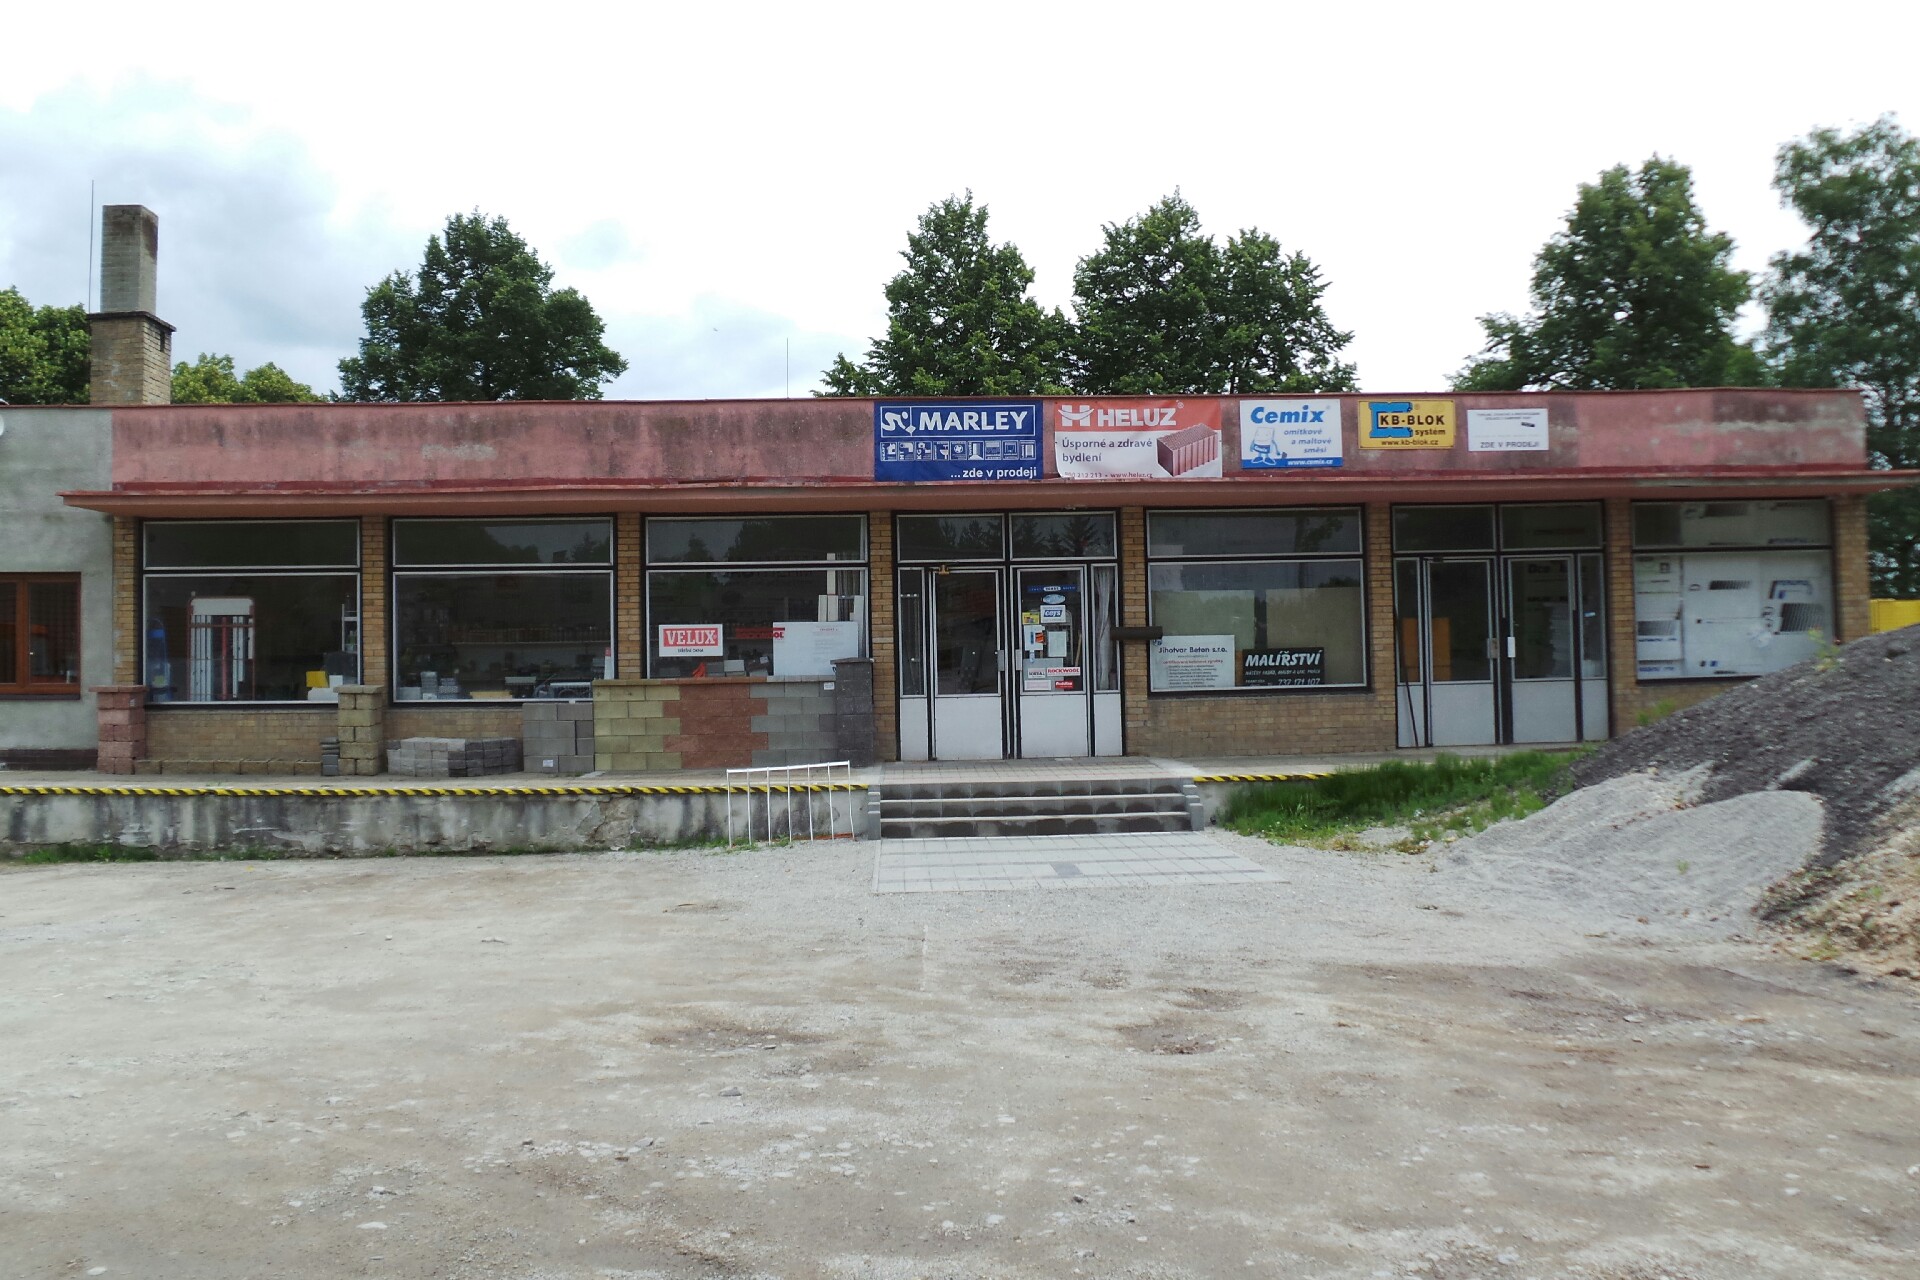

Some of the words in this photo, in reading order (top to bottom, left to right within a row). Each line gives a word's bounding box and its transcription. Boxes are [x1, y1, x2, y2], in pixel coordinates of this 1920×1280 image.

[919, 411, 1027, 430] MARLEY
[1098, 408, 1176, 427] HELUZ
[1251, 405, 1325, 424] Cemix
[1380, 415, 1445, 425] KB-BLOK
[1062, 437, 1106, 450] Úsporné
[1109, 440, 1115, 448] a
[1117, 438, 1152, 448] zdravé
[1062, 452, 1101, 464] bydlení
[986, 469, 994, 477] v
[996, 467, 1037, 479] prodeji
[665, 629, 716, 645] VELUX
[1245, 650, 1323, 666] MALÍŘSTVÍ
